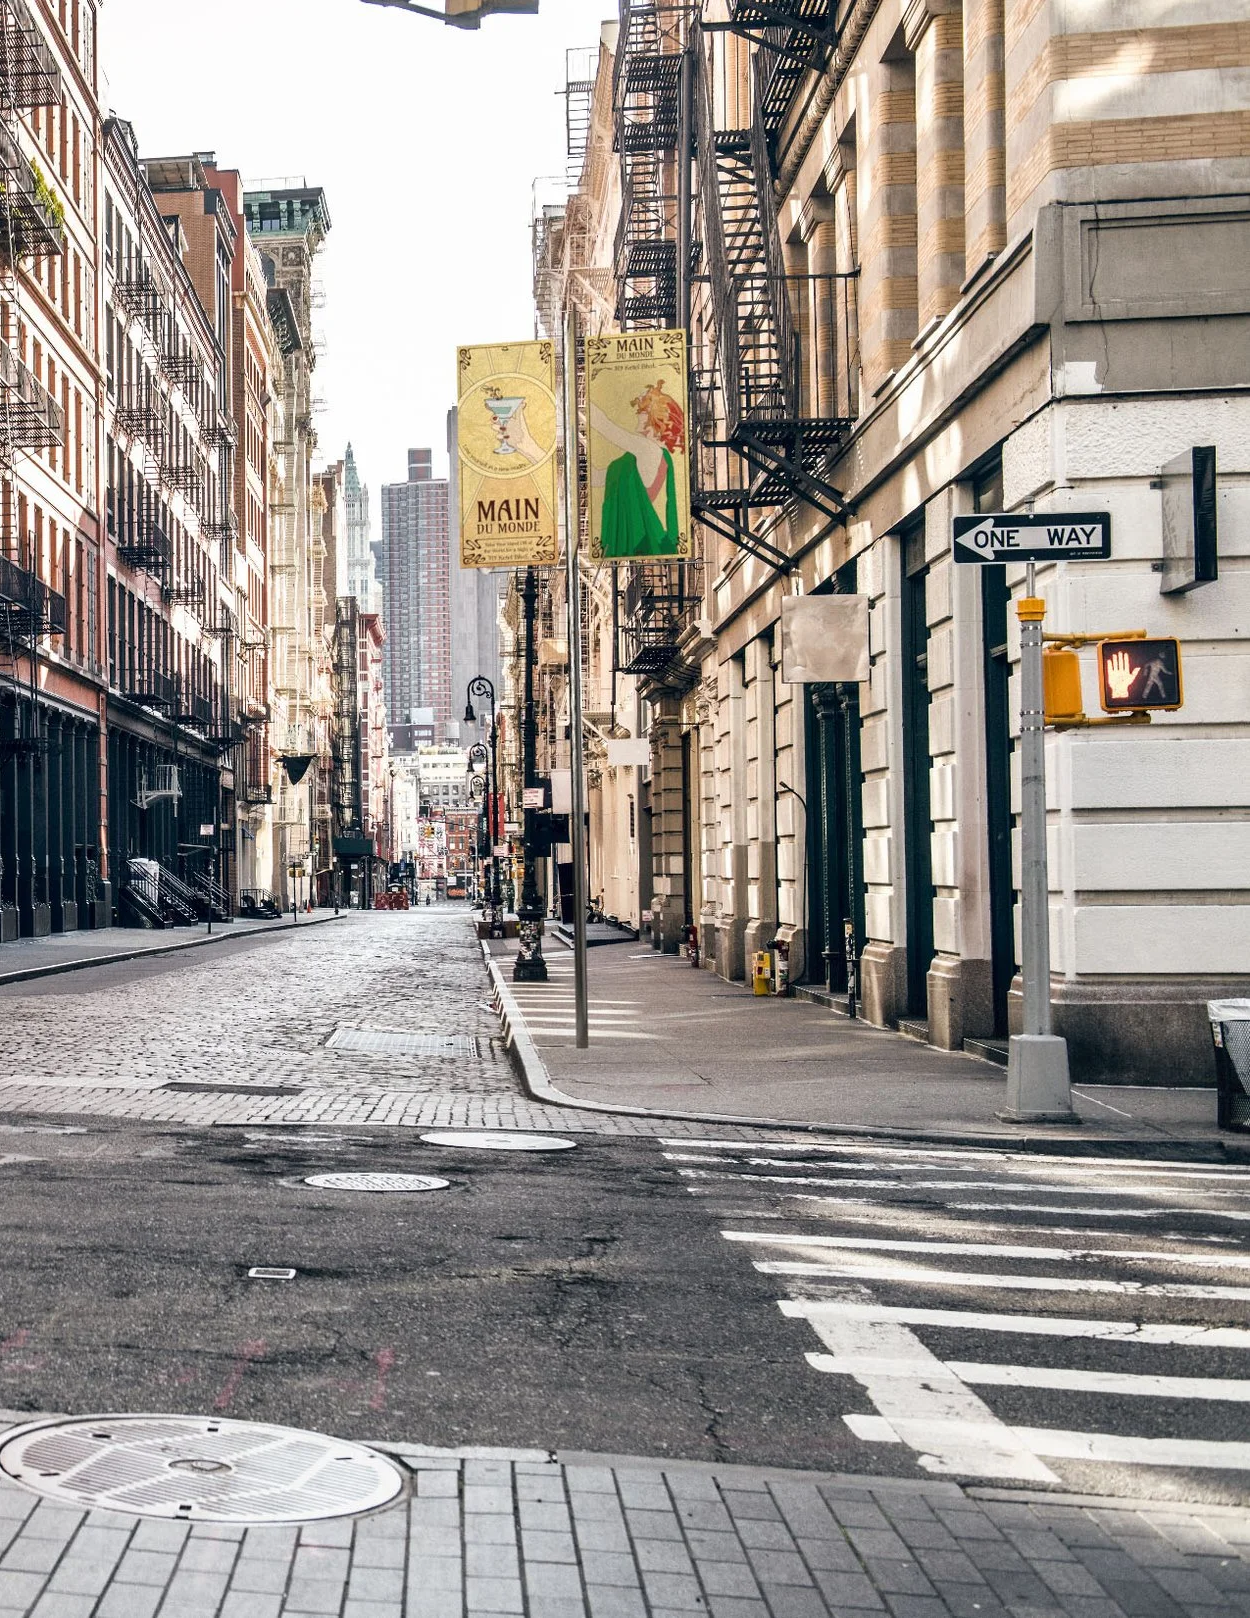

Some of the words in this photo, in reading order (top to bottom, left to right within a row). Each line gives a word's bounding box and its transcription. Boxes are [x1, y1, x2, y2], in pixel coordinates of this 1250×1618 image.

[616, 337, 654, 353] MAIN
[616, 352, 626, 360] DU
[629, 350, 654, 359] MONDE
[477, 497, 539, 523] MAIN
[477, 523, 493, 535] DU
[498, 521, 541, 534] MONDE
[974, 529, 1020, 549] ONE
[1046, 526, 1097, 546] WAY
